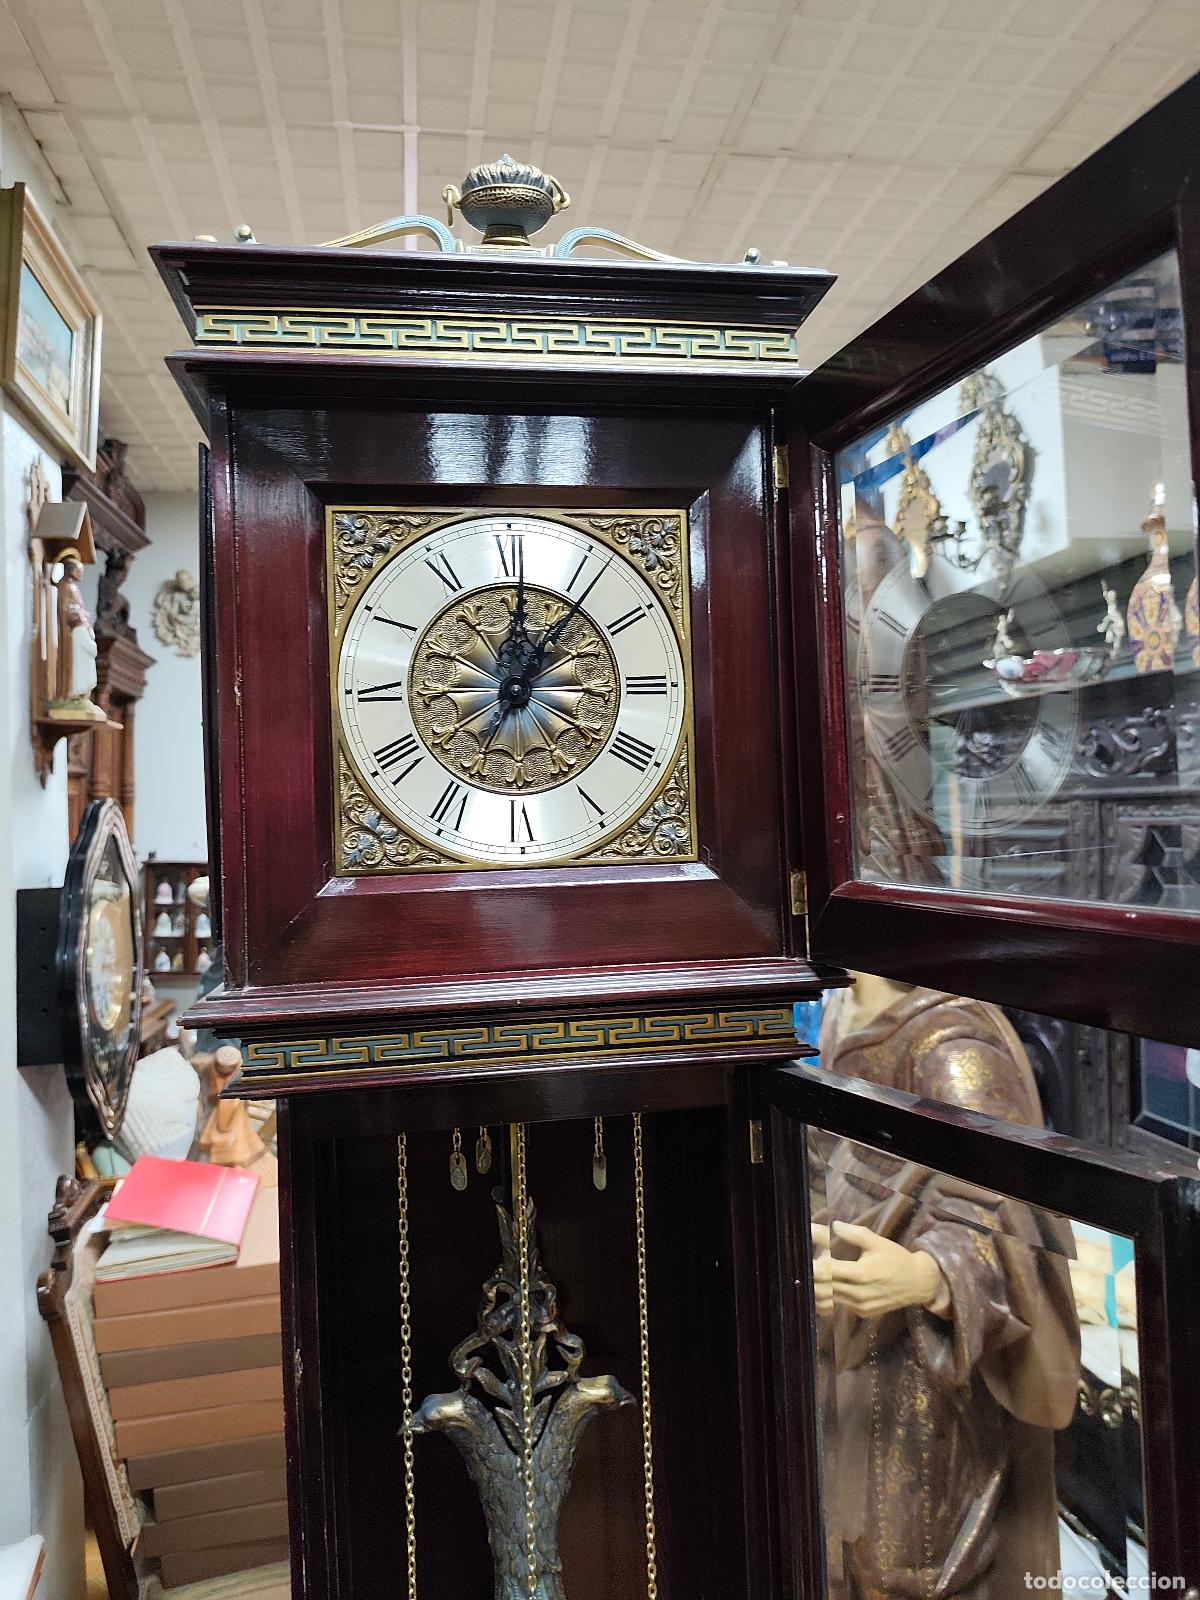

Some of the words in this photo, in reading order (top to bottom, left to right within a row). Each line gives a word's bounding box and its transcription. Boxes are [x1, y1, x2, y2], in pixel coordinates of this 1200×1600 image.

[424, 553, 465, 597] XI
[493, 534, 523, 578] XII
[565, 554, 591, 592] I
[372, 605, 417, 641] X
[604, 604, 648, 638] II
[357, 680, 403, 705] IX
[625, 675, 667, 696] III
[371, 731, 426, 788] VIII
[607, 727, 656, 774] IIII
[427, 779, 470, 834] VII
[508, 799, 536, 843] VI
[576, 785, 607, 823] V
